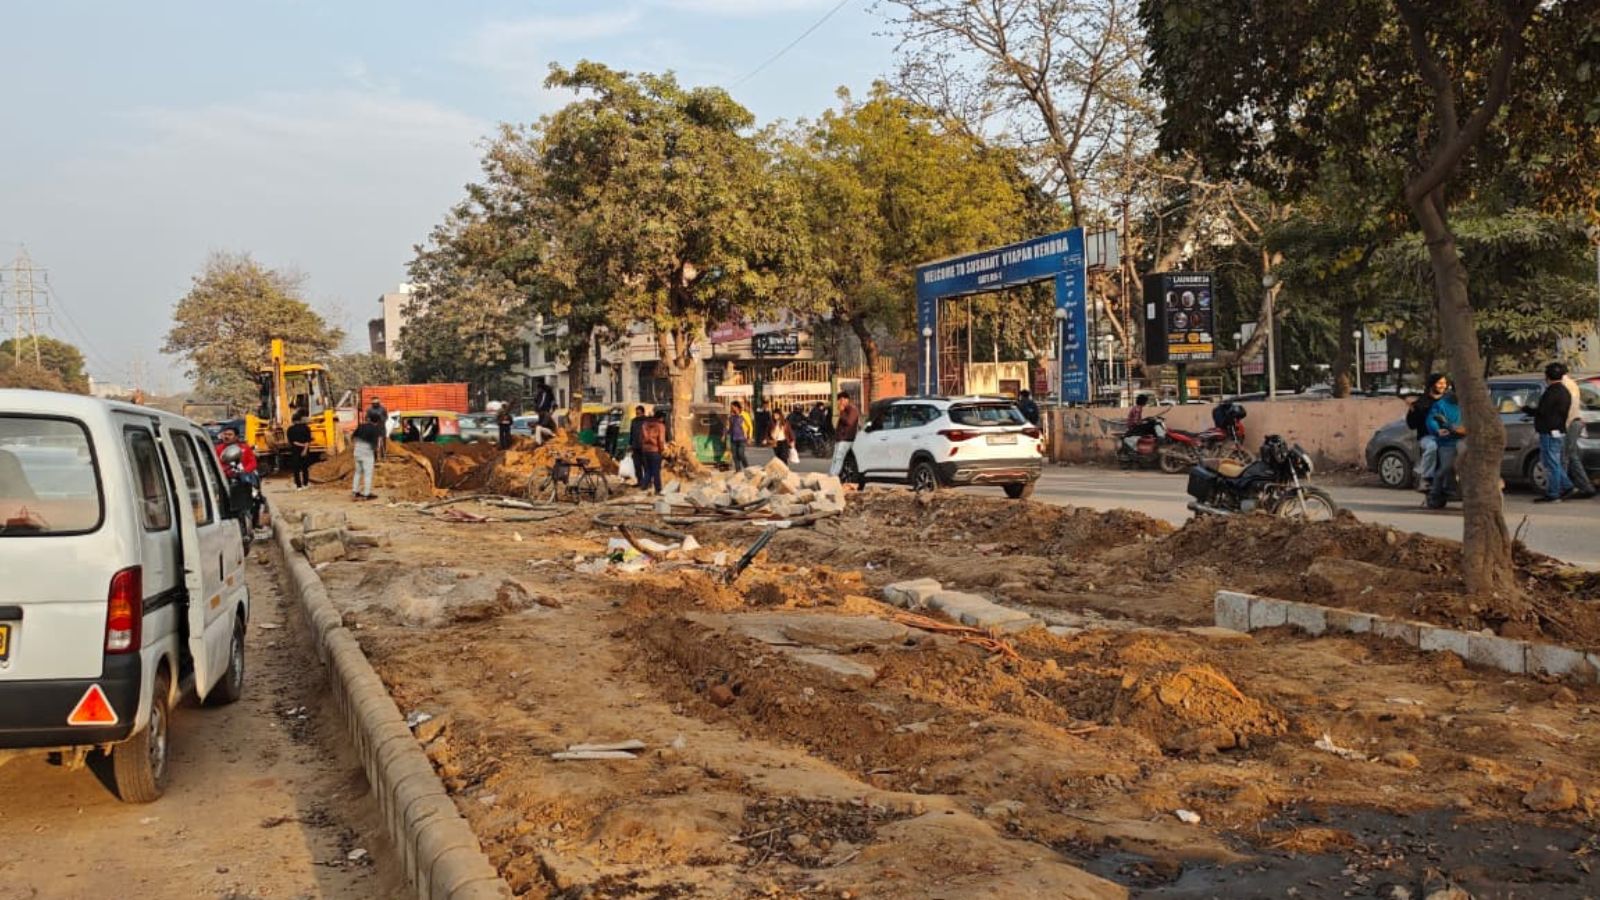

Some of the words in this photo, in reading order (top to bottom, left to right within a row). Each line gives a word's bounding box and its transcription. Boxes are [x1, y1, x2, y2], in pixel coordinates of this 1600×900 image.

[924, 268, 955, 284] WELCOME
[956, 264, 965, 276] TO
[966, 255, 999, 274] SUSHANT
[1002, 247, 1032, 266] VYAPAR
[1034, 238, 1069, 258] KENDRA
